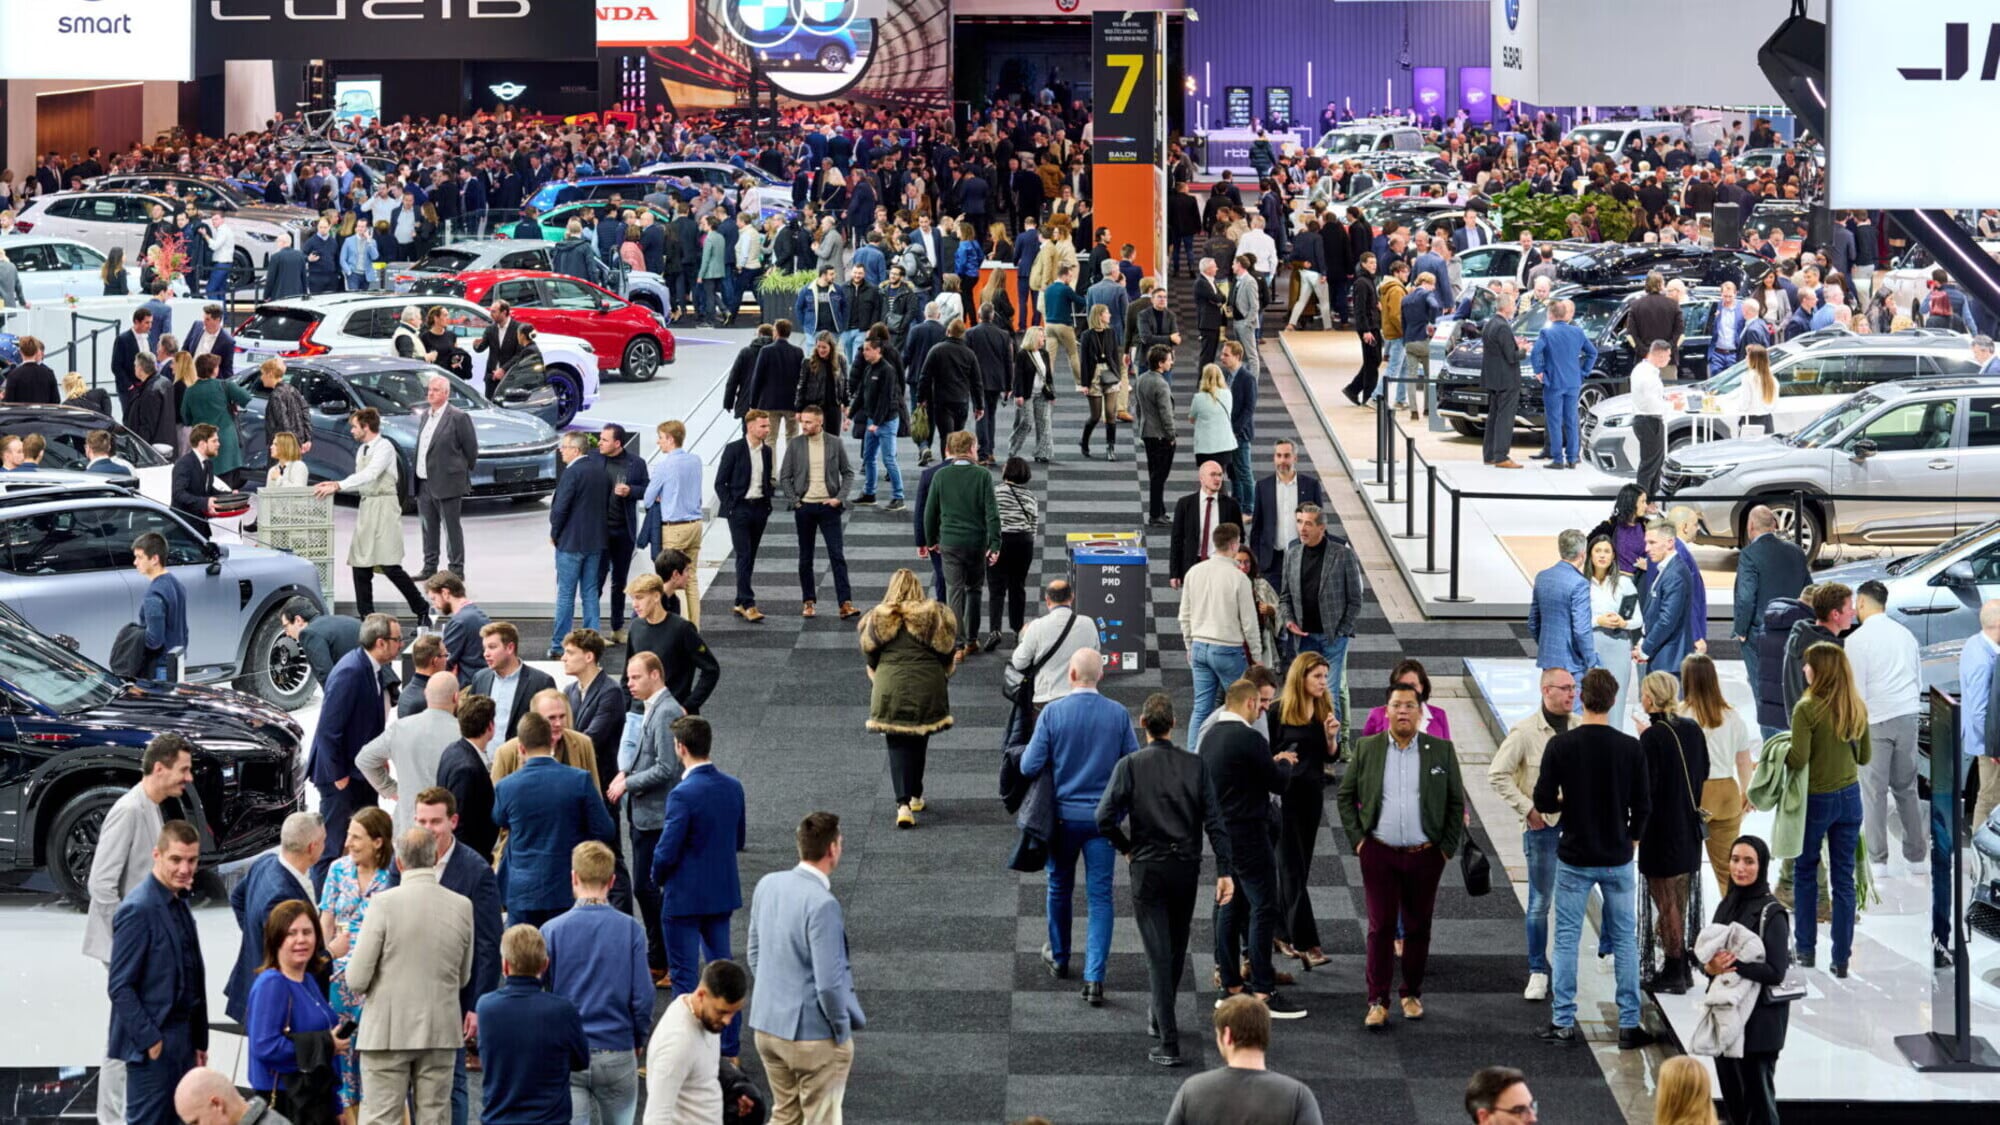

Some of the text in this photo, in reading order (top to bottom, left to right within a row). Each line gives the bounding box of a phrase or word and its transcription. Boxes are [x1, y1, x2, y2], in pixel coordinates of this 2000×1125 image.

[58, 13, 131, 34] smart
[1106, 54, 1144, 114] 7
[1101, 565, 1121, 574] PMC
[1101, 577, 1121, 586] PMD
